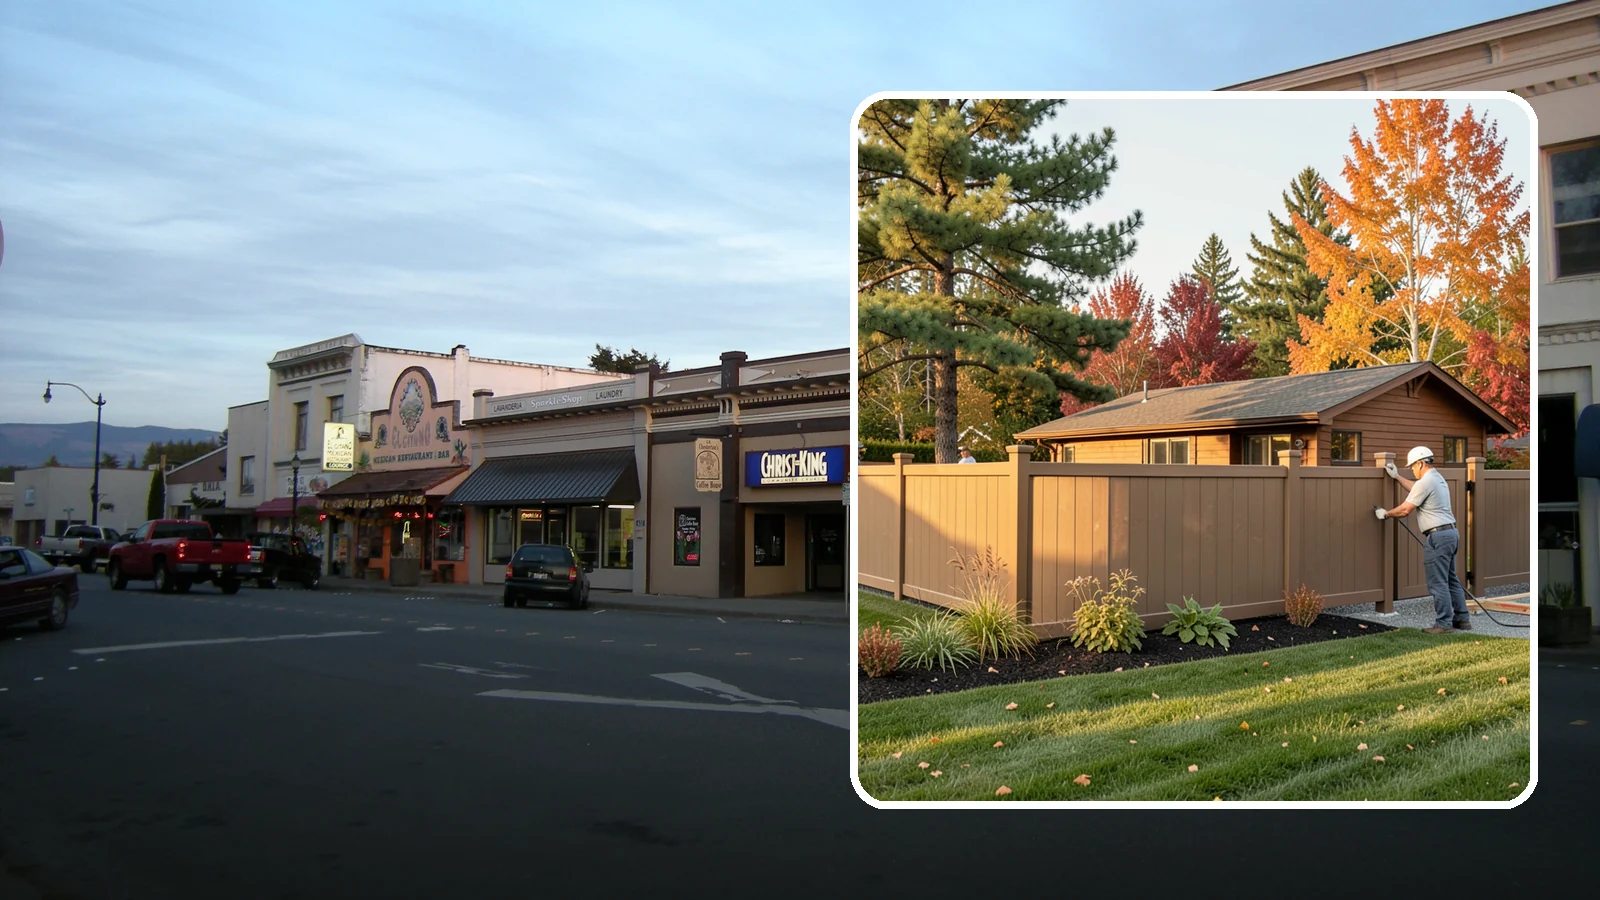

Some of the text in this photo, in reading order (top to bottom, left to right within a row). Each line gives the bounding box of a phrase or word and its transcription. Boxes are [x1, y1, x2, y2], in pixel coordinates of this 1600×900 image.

[531, 394, 582, 409] Sparkle Shop
[595, 389, 623, 400] LAUNDRY
[493, 402, 522, 412] LAVANDERIA
[373, 455, 396, 464] MEXICAN
[397, 451, 433, 462] RESTAURANT
[438, 450, 450, 459] BAR
[761, 449, 827, 478] CHRIST KING
